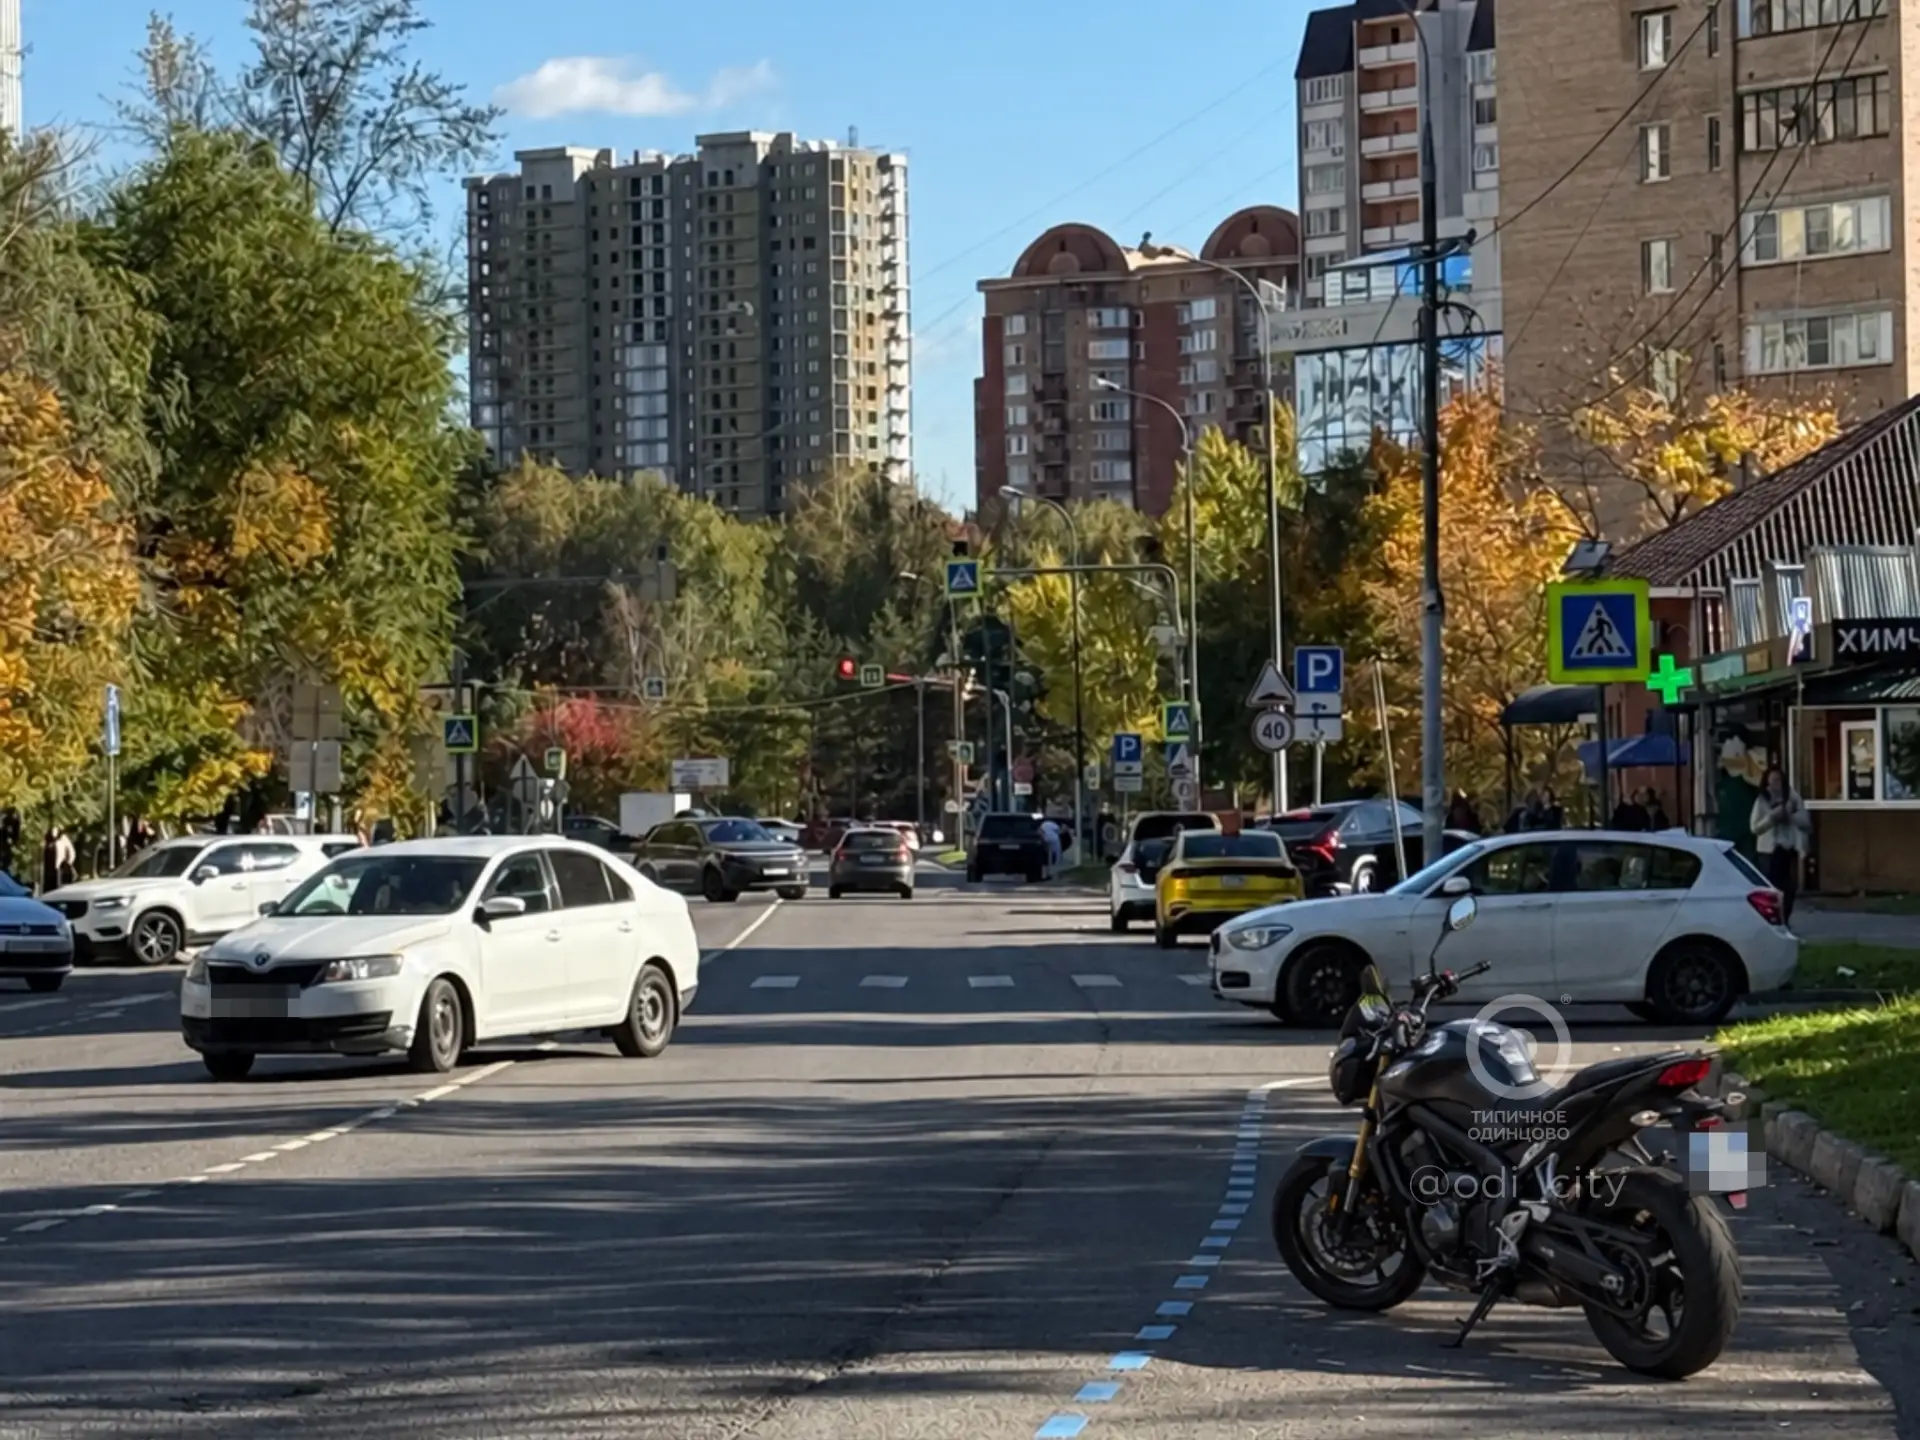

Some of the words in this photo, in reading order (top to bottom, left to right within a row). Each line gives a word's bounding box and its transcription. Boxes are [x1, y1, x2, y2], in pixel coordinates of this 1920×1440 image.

[1308, 653, 1334, 689] P
[1262, 721, 1285, 740] 40
[1121, 736, 1137, 758] P
